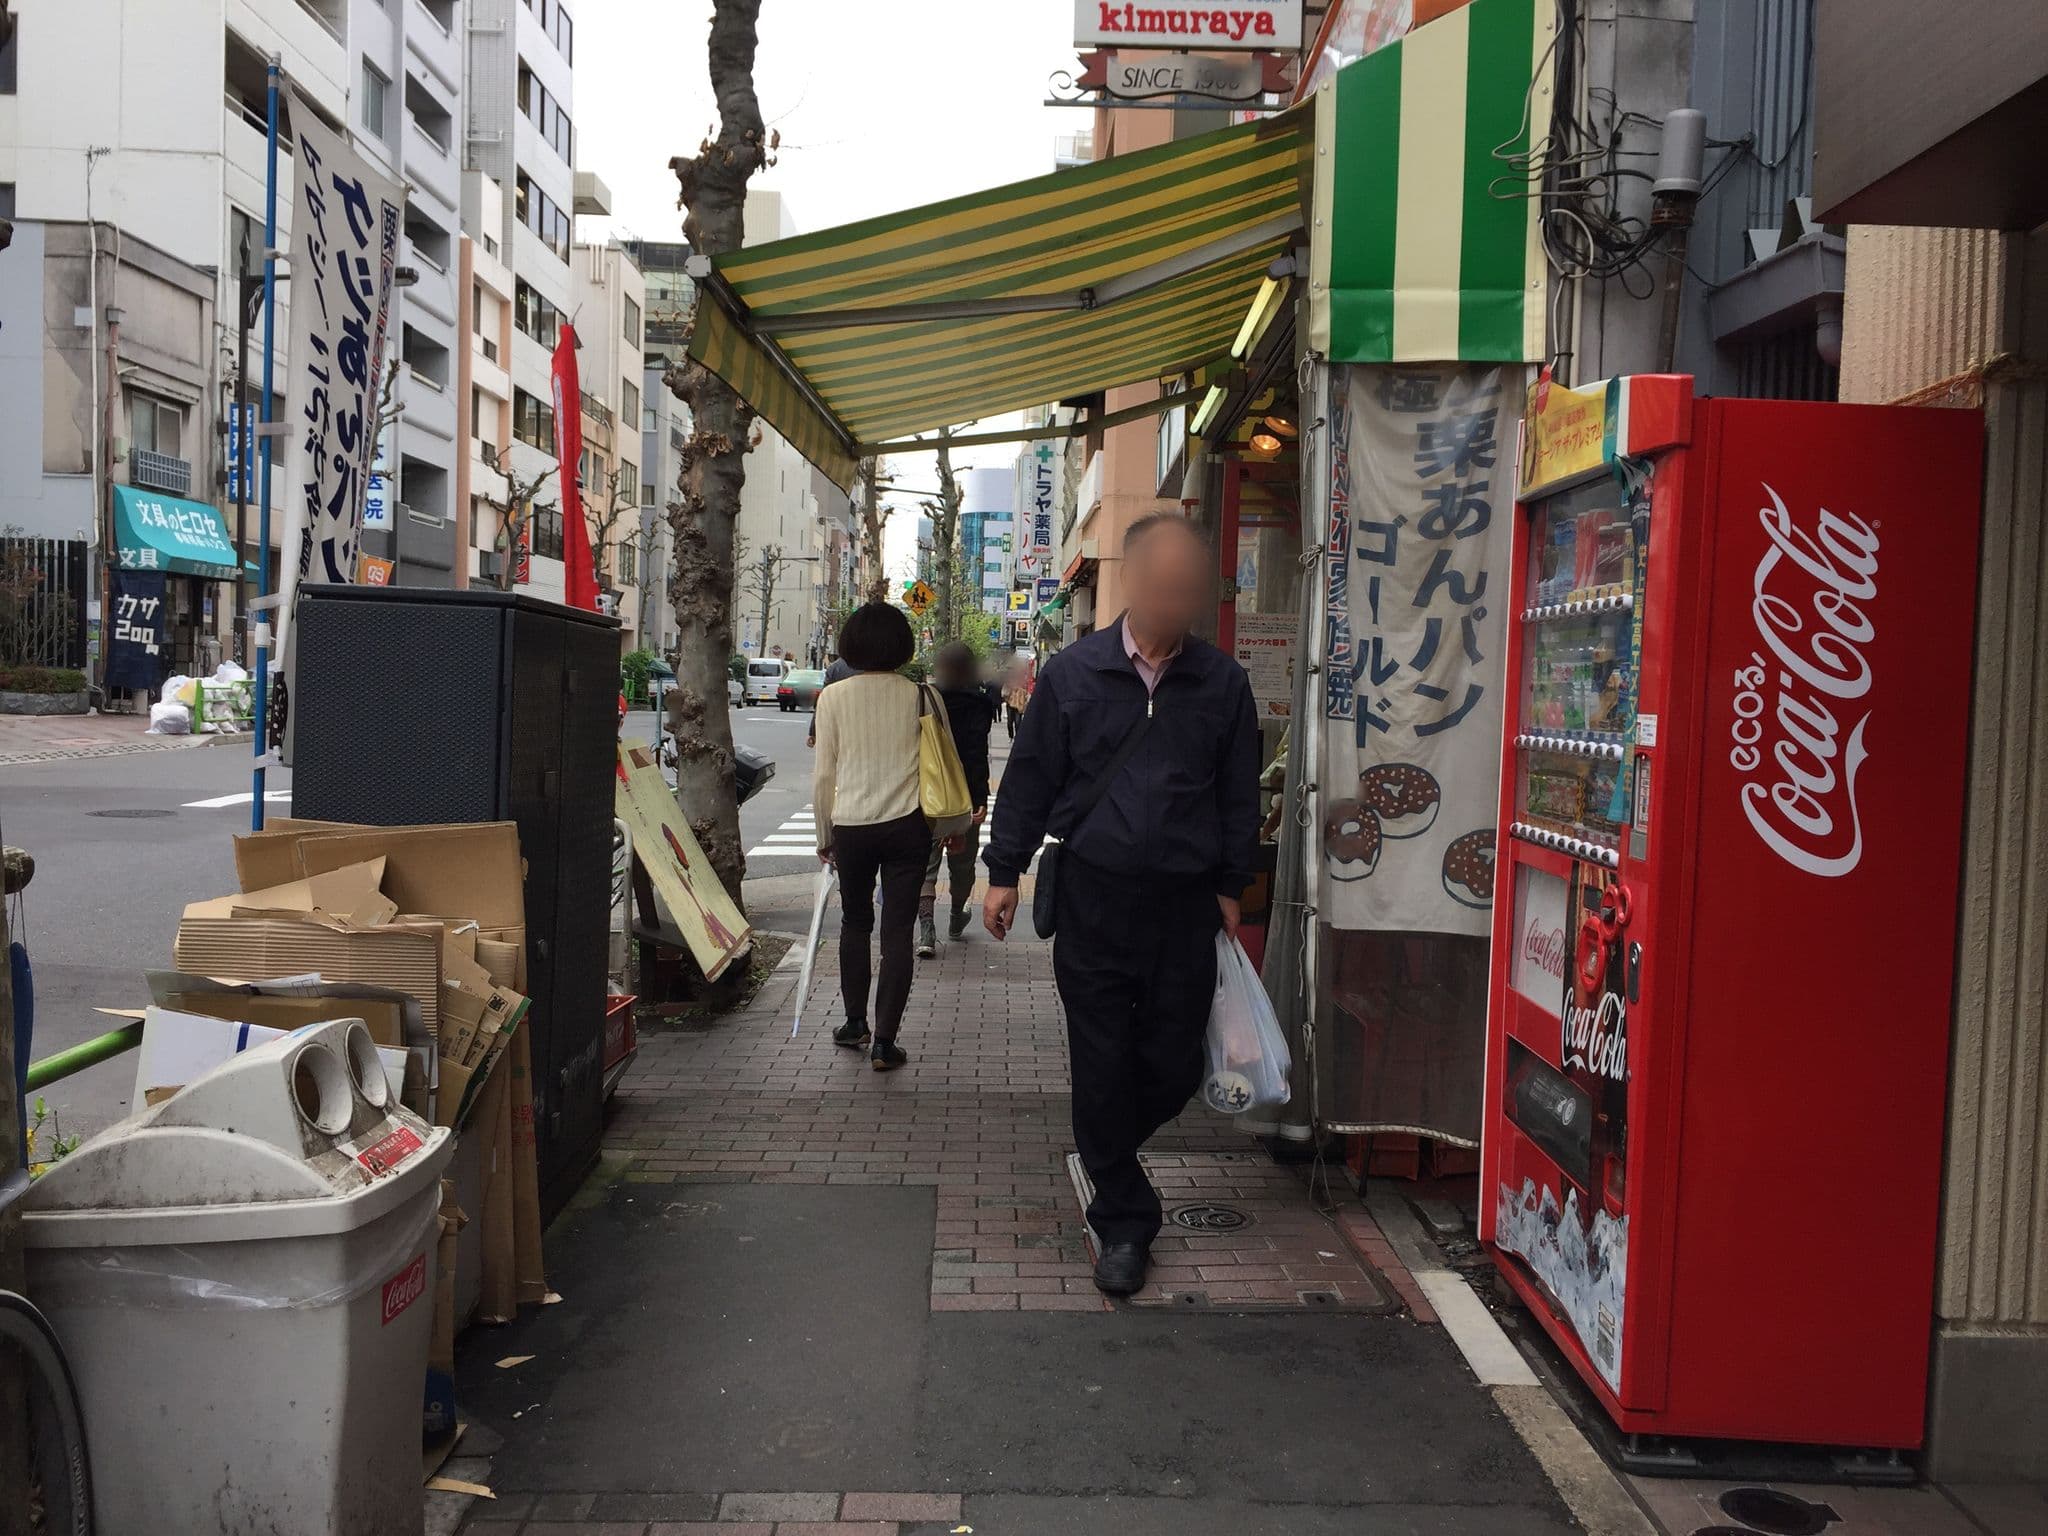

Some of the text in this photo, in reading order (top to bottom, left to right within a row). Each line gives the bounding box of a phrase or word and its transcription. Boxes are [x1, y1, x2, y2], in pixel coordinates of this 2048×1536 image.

[1099, 3, 1275, 40] kimuraya
[1121, 67, 1183, 89] SINCE
[135, 499, 219, 538] 文具のヒロセ
[1033, 464, 1052, 547] トラヤ薬局
[118, 547, 160, 569] 文具
[1408, 406, 1499, 738] 栗あんパン
[117, 593, 160, 621] カサ
[1009, 593, 1027, 610] P
[1351, 515, 1408, 749] ゴールド
[1741, 482, 1880, 877] Coca-Cola
[1524, 916, 1567, 980] Coca-Cola
[1561, 986, 1627, 1082] Coca-Cola
